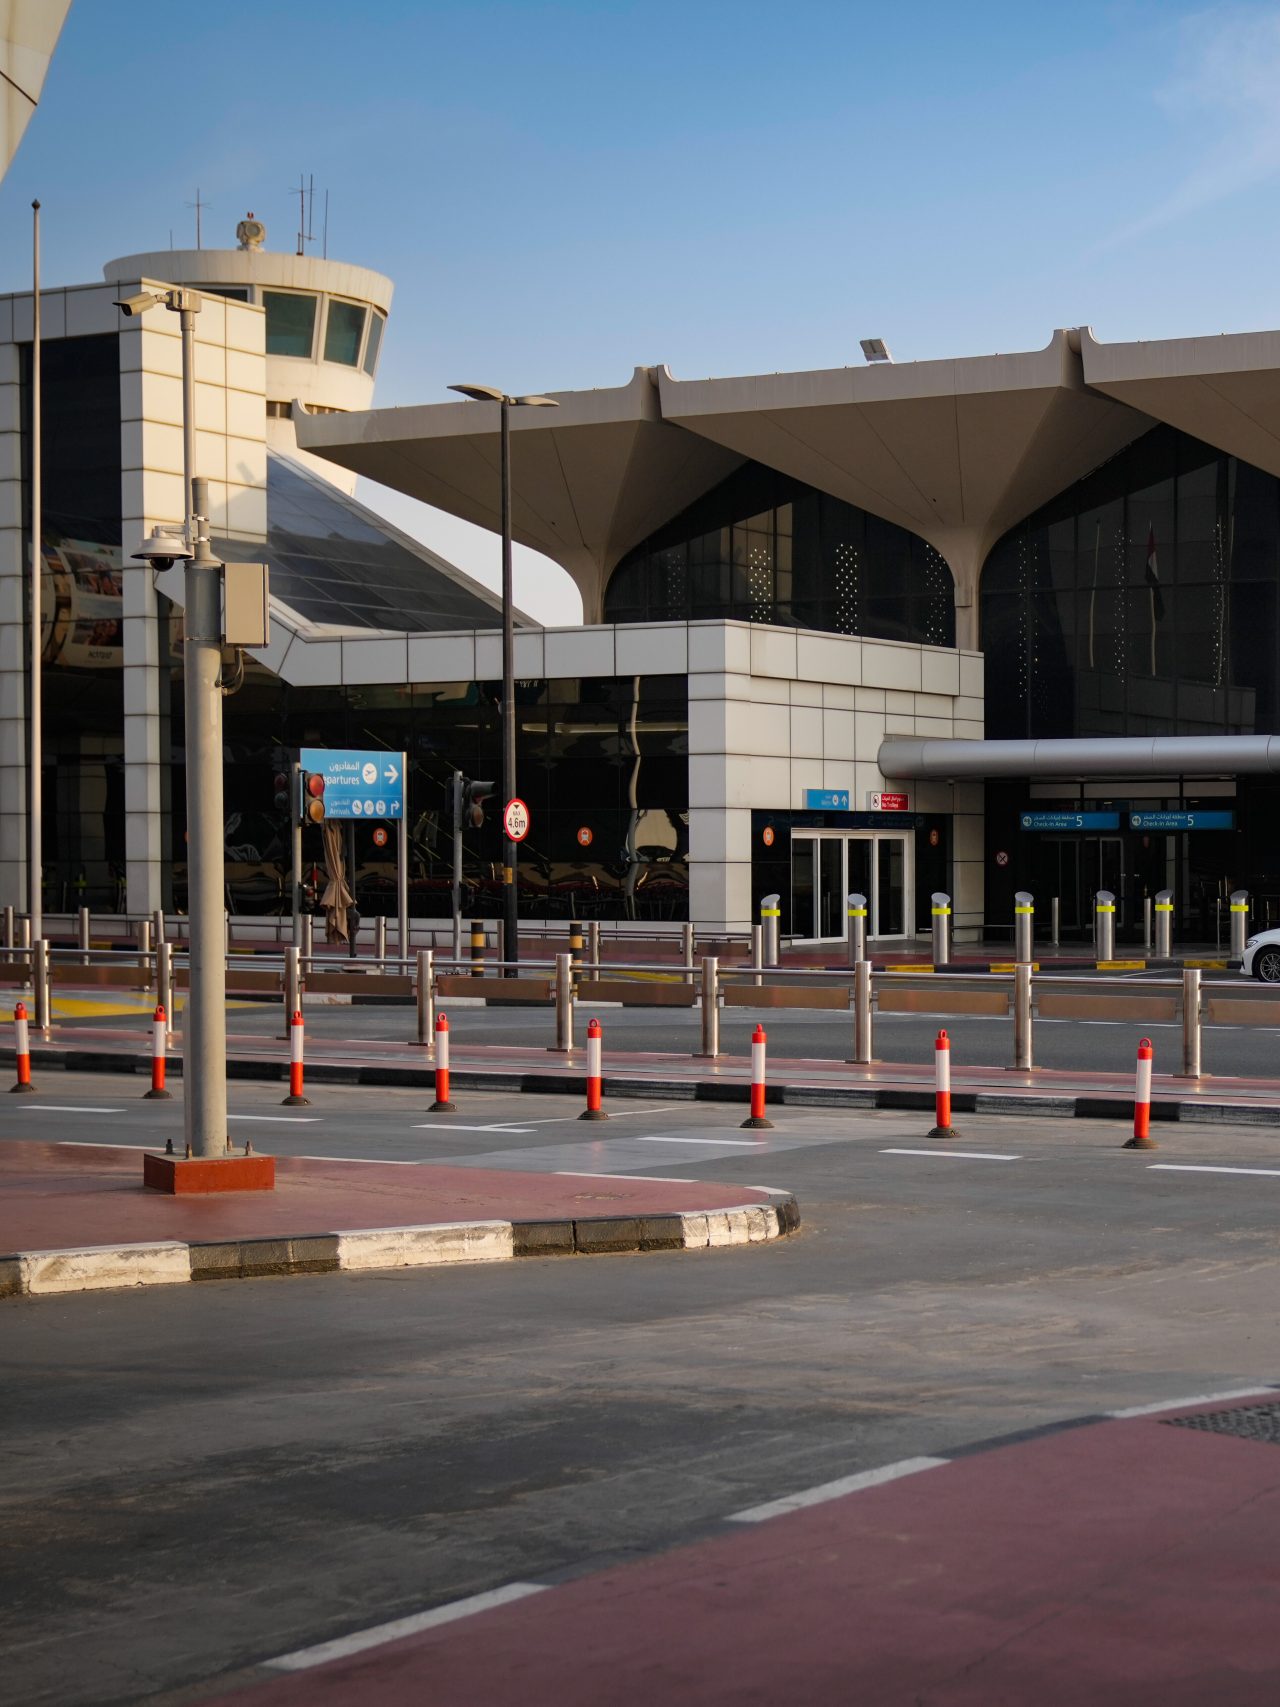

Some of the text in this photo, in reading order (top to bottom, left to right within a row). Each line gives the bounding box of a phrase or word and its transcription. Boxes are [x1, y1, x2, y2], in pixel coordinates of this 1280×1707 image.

[323, 775, 360, 787] epartures
[508, 817, 526, 828] 4.6m
[1076, 815, 1083, 827] 5
[1187, 814, 1194, 826] 5
